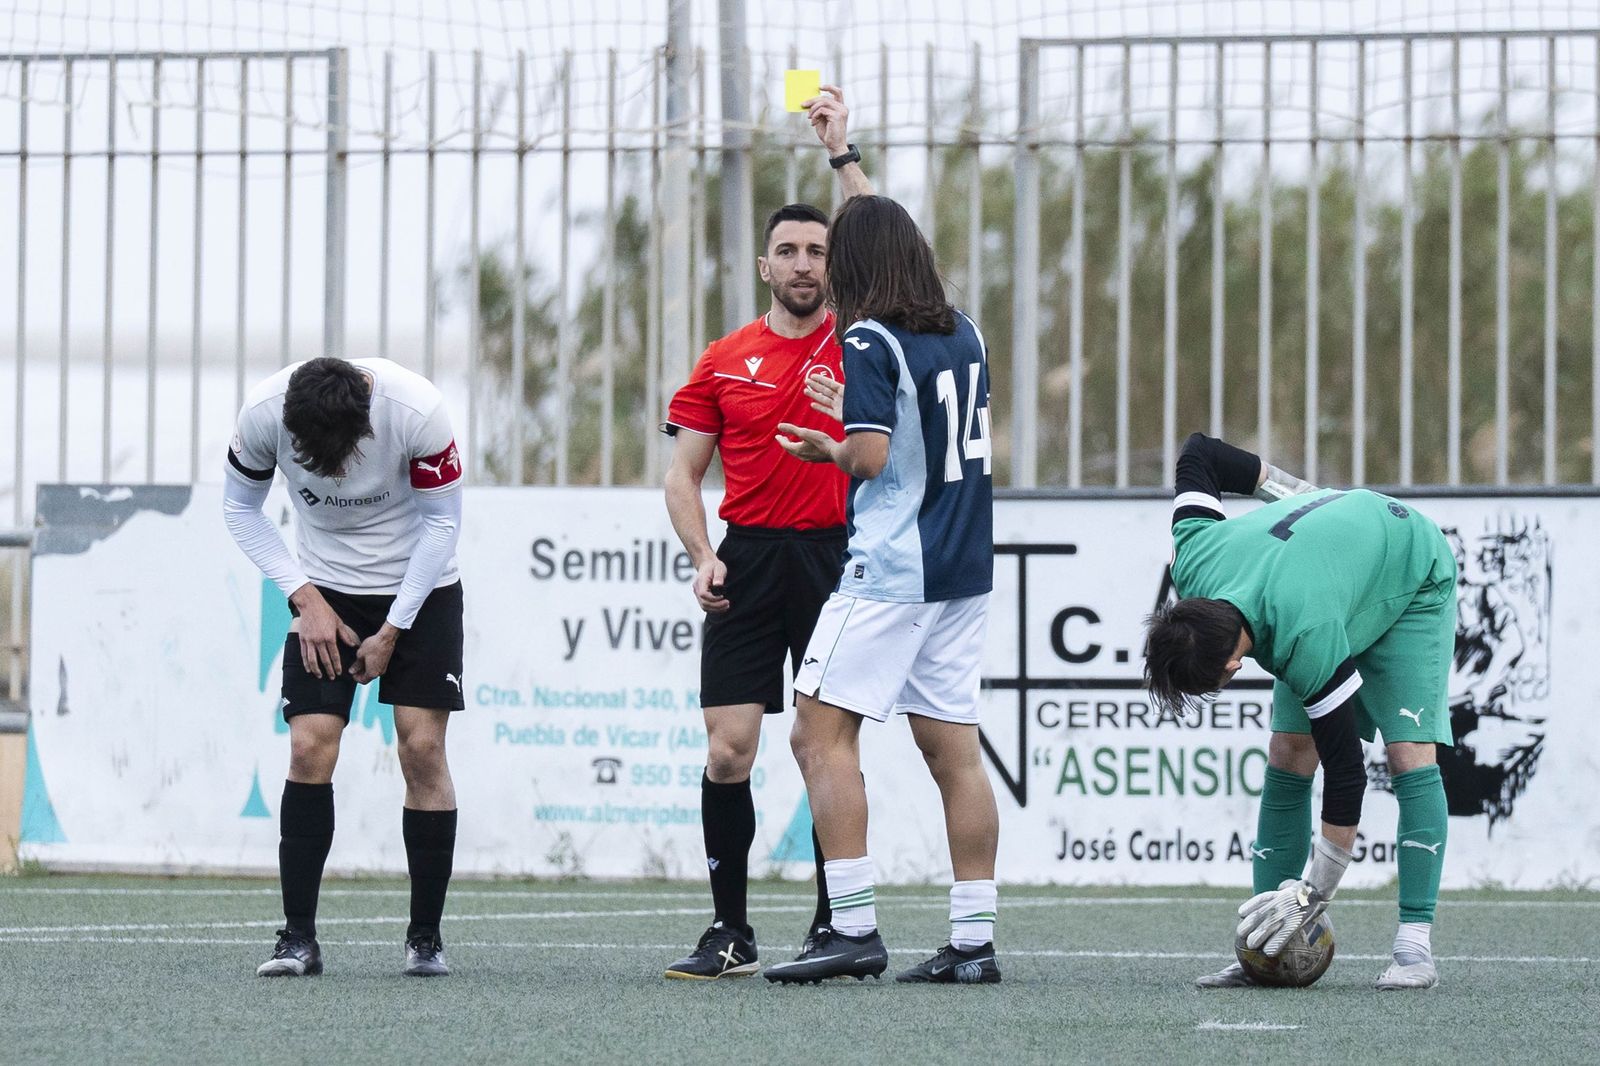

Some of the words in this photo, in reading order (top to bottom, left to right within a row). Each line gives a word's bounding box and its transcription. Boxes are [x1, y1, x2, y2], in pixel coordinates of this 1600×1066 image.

[936, 362, 992, 483] 14
[324, 491, 390, 508] Alprosan
[530, 537, 694, 583] Semille
[562, 617, 585, 662] y
[602, 606, 703, 652] Vive
[476, 683, 526, 707] Ctra.
[533, 685, 627, 708] Nacional
[686, 689, 700, 710] K
[495, 721, 566, 746] Puebla
[573, 723, 599, 747] de
[631, 764, 672, 787] 950
[679, 765, 703, 788] 55
[1057, 827, 1117, 862] José
[1129, 827, 1215, 862] Carlos
[1350, 832, 1398, 864] Gar
